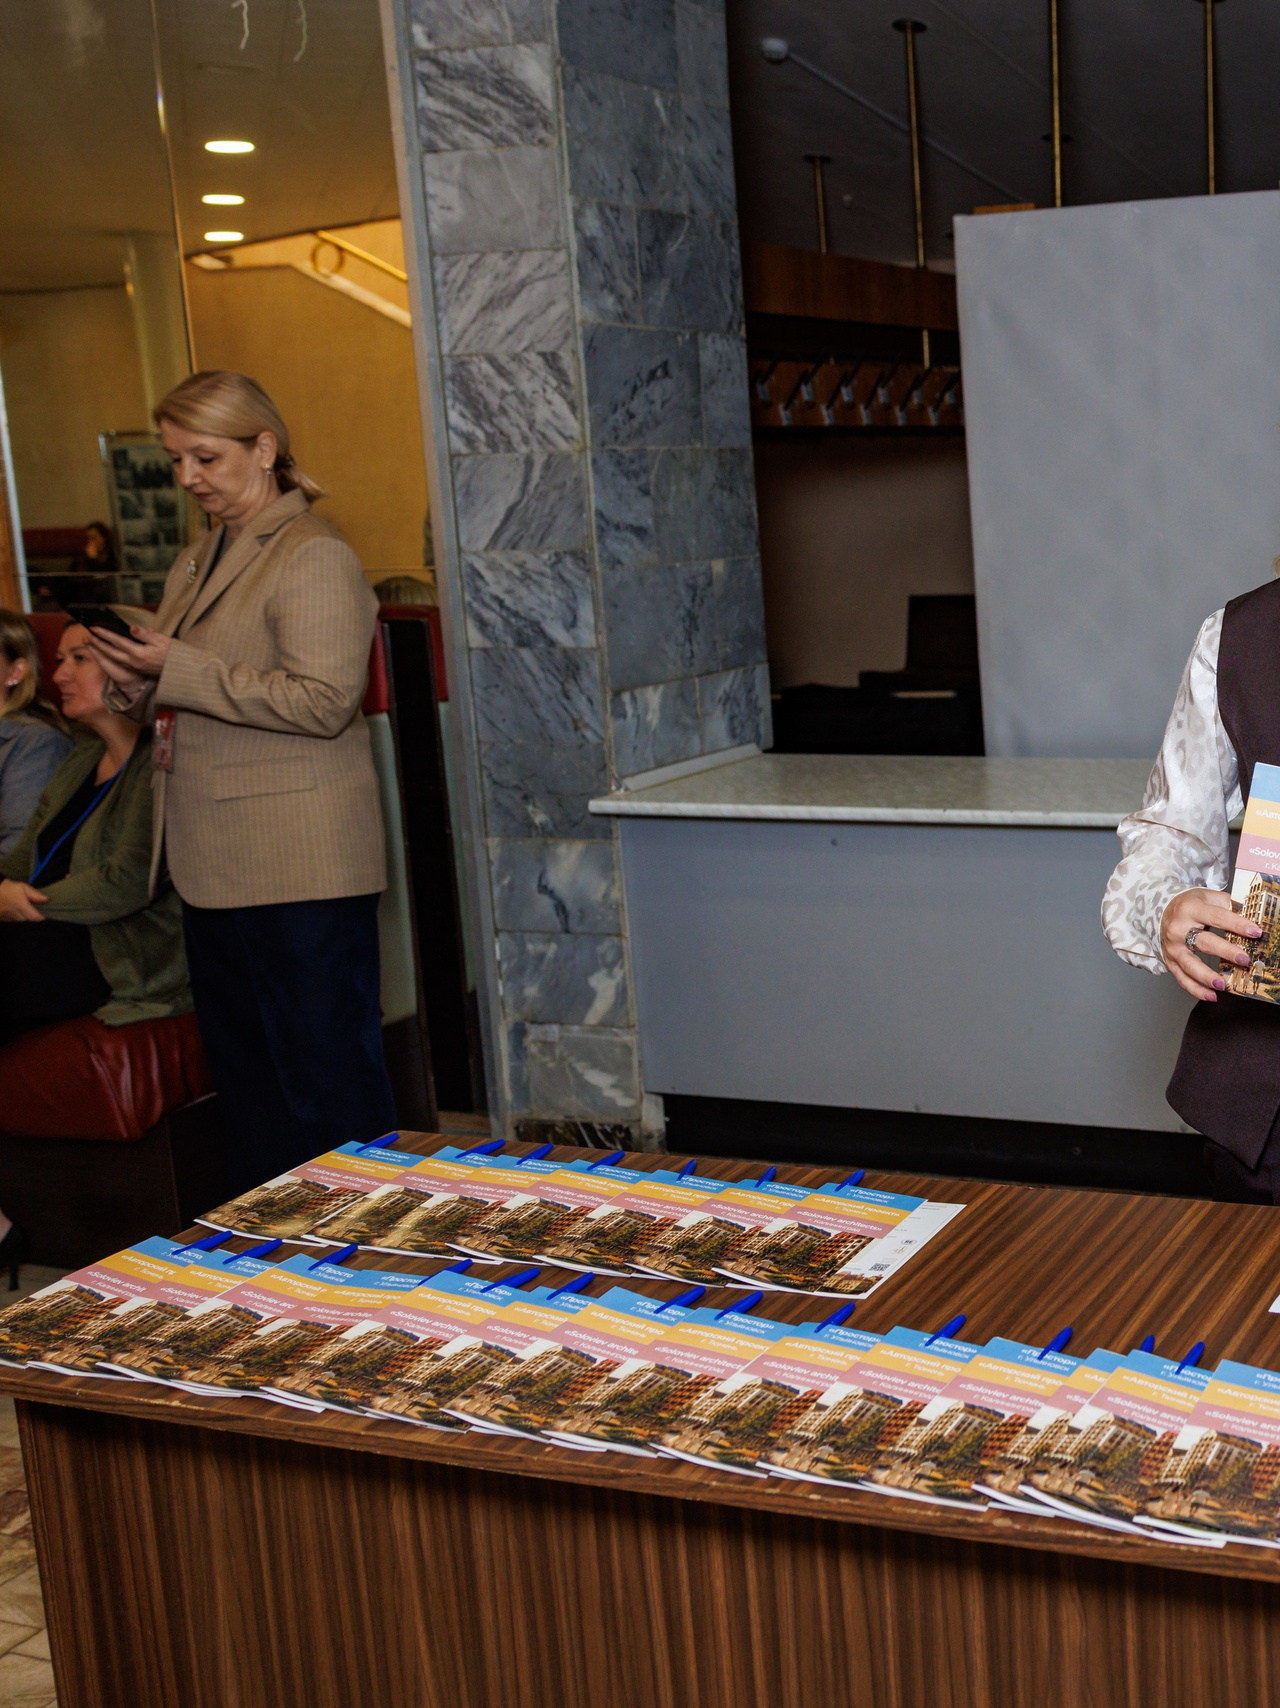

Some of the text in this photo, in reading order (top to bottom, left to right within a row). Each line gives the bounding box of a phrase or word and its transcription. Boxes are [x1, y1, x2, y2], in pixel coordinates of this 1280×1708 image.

[307, 1168, 343, 1180] «Soloviev
[539, 1186, 575, 1197] «Soloviev
[766, 1184, 810, 1194] «Простор»
[850, 1188, 895, 1200] «Простор»
[625, 1197, 662, 1209] «Soloviev
[711, 1203, 748, 1215] «Soloviev
[815, 1197, 899, 1217] «Авторский проект»
[797, 1210, 882, 1232] «Soloviev architects»
[241, 1290, 280, 1305] «Soloviev
[418, 1292, 471, 1309] «Авторский
[390, 1310, 432, 1325] «Soloviev
[591, 1311, 643, 1330] «Авторский
[724, 1314, 774, 1330] «Простор»
[487, 1324, 529, 1340] «Soloviev
[565, 1329, 607, 1346] «Soloviev
[679, 1327, 735, 1343] «Авторский
[655, 1346, 699, 1360] «Soloviev
[785, 1341, 843, 1358] «Авторский
[880, 1349, 940, 1367] «Авторский
[763, 1360, 808, 1375] «Soloviev
[979, 1362, 1041, 1379] «Авторский
[860, 1369, 906, 1385] «Soloviev
[959, 1383, 1008, 1401] «Soloviev
[1123, 1374, 1188, 1398] «Авторский
[1107, 1396, 1157, 1416] «Soloviev
[1205, 1410, 1258, 1427] «Soloviev
